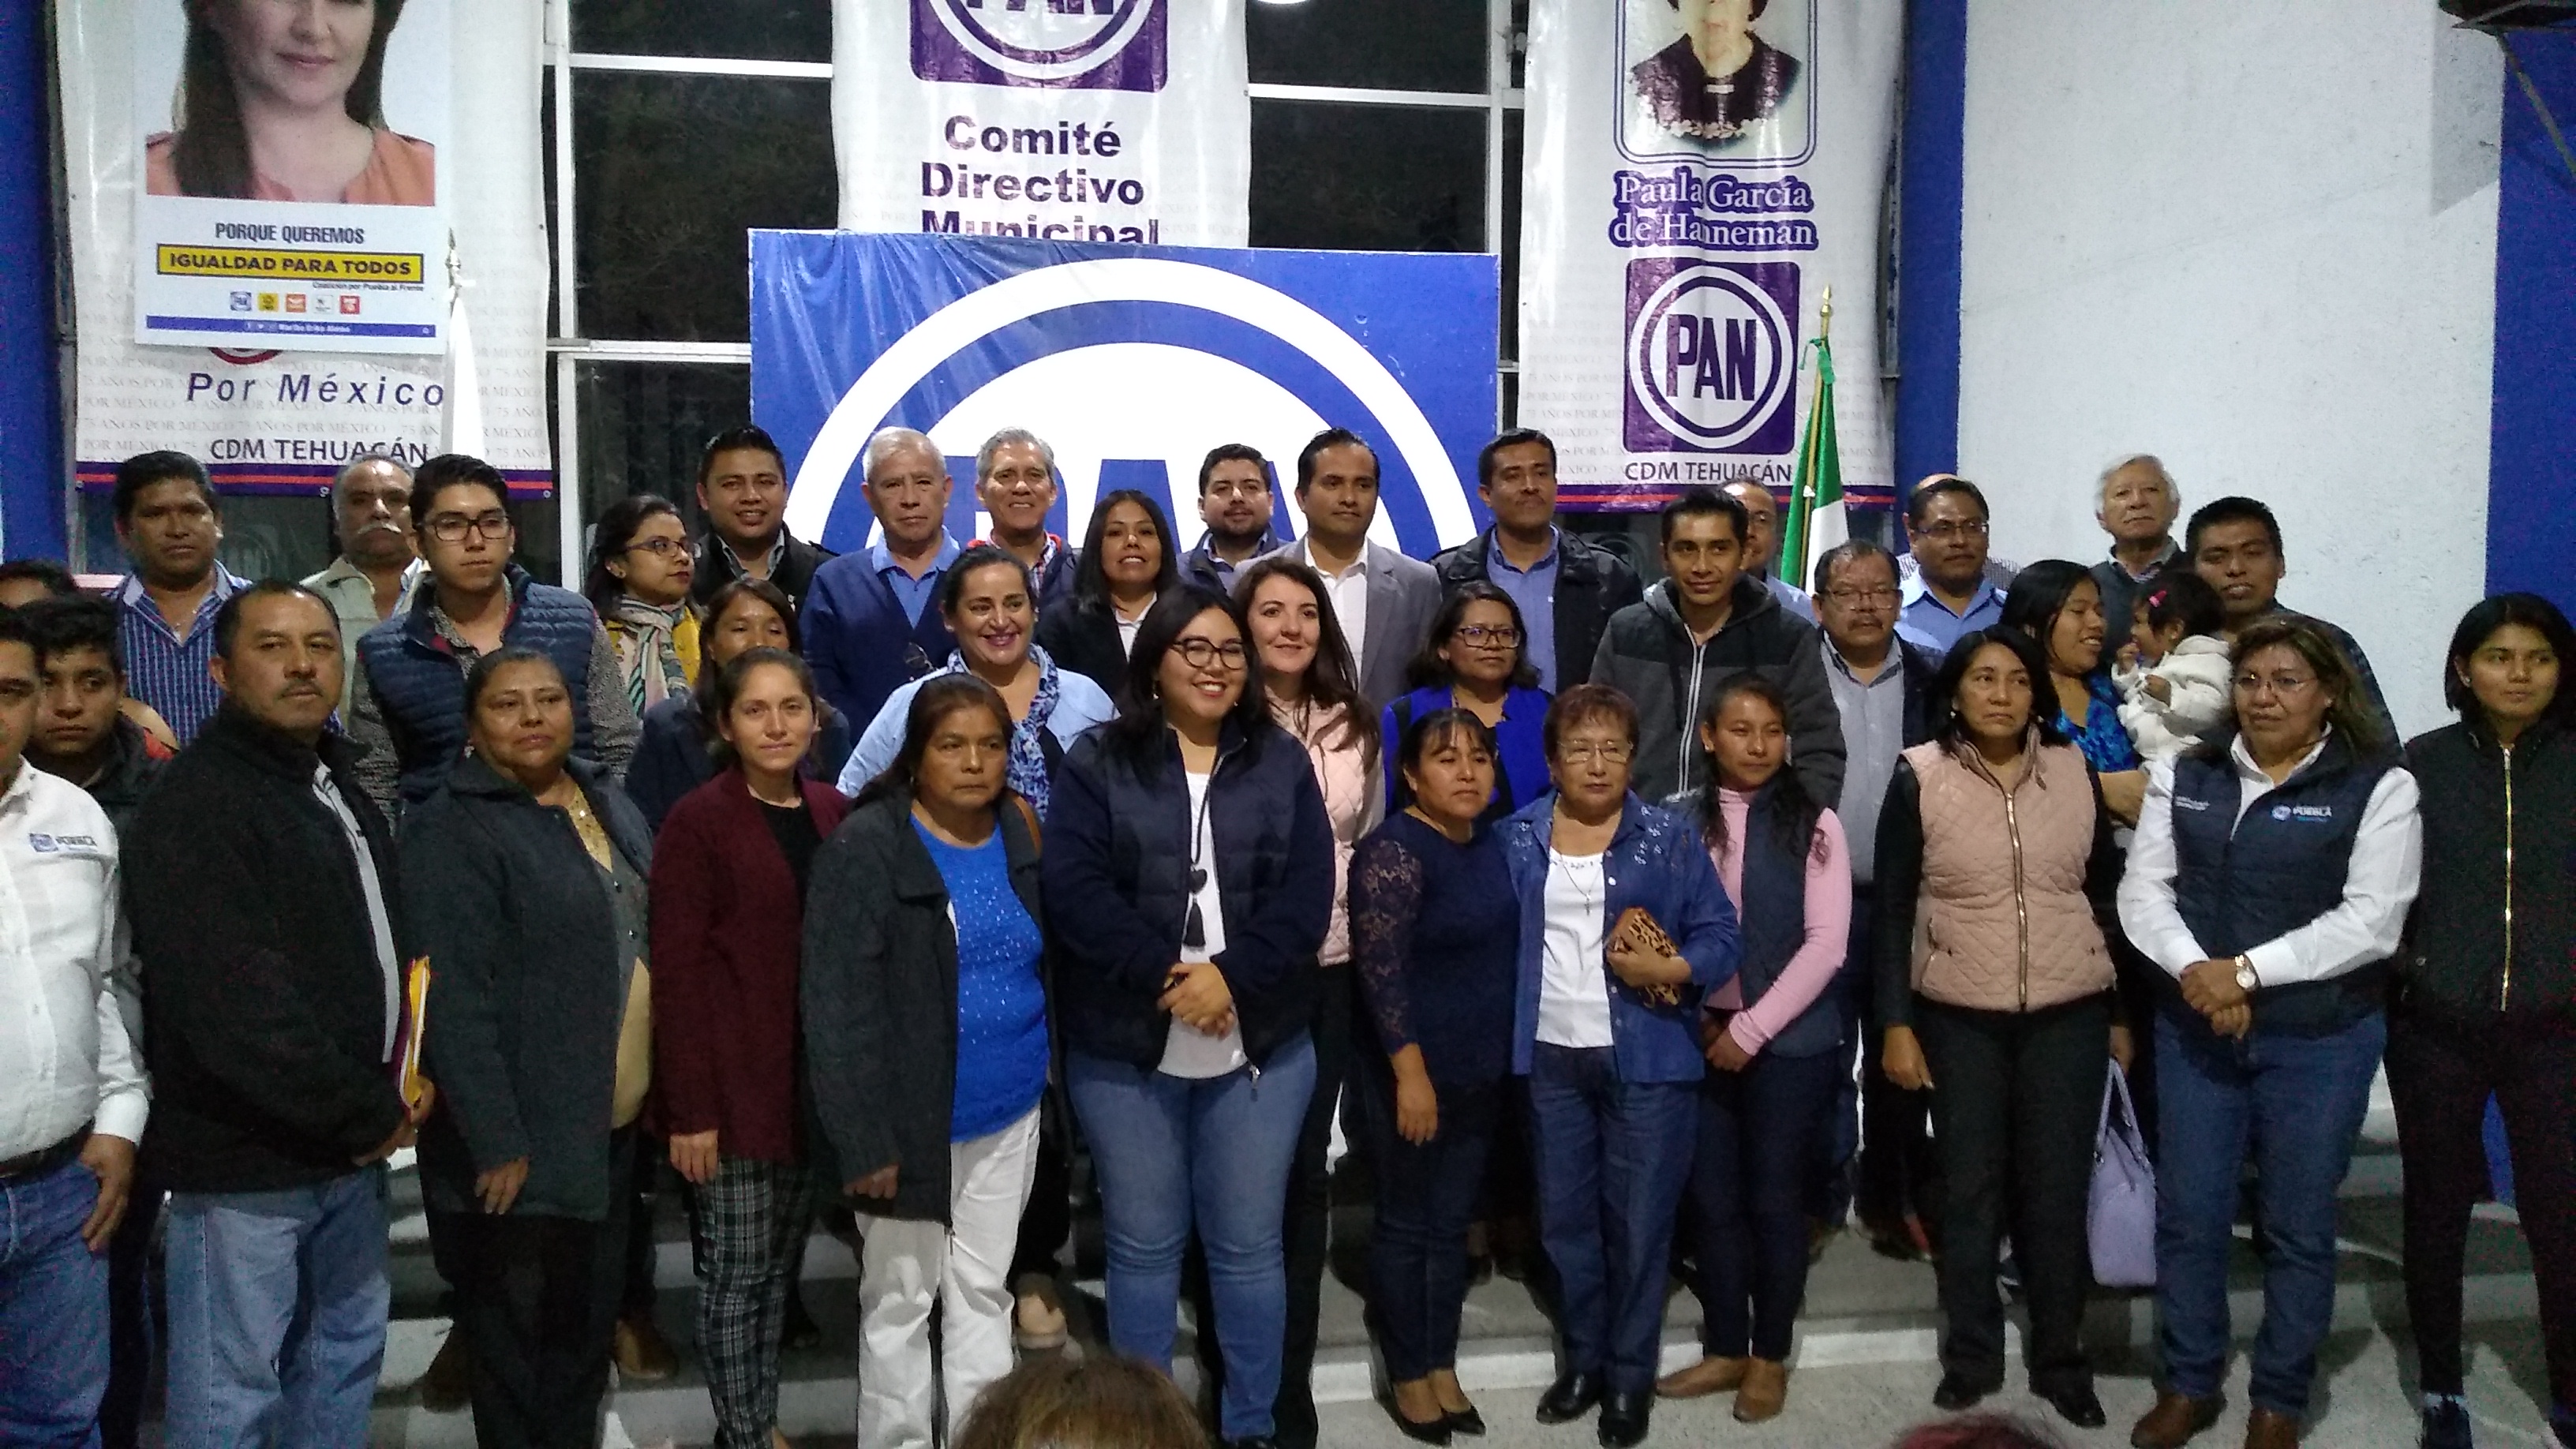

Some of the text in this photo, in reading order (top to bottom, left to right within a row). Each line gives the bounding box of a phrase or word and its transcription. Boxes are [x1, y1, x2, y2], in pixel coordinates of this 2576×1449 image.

[944, 114, 1121, 157] Comité
[921, 161, 1144, 205] Directivo
[1618, 172, 1809, 208] Paula García
[215, 222, 365, 245] PORQUE QUEREMOS
[1613, 212, 1652, 242] de
[170, 253, 411, 275] IGUALDAD PARA TODOS
[1666, 313, 1758, 402] PAN
[186, 372, 444, 406] Por México
[210, 438, 265, 460] CDM
[1625, 459, 1792, 482] CDM TEHUACÁN
